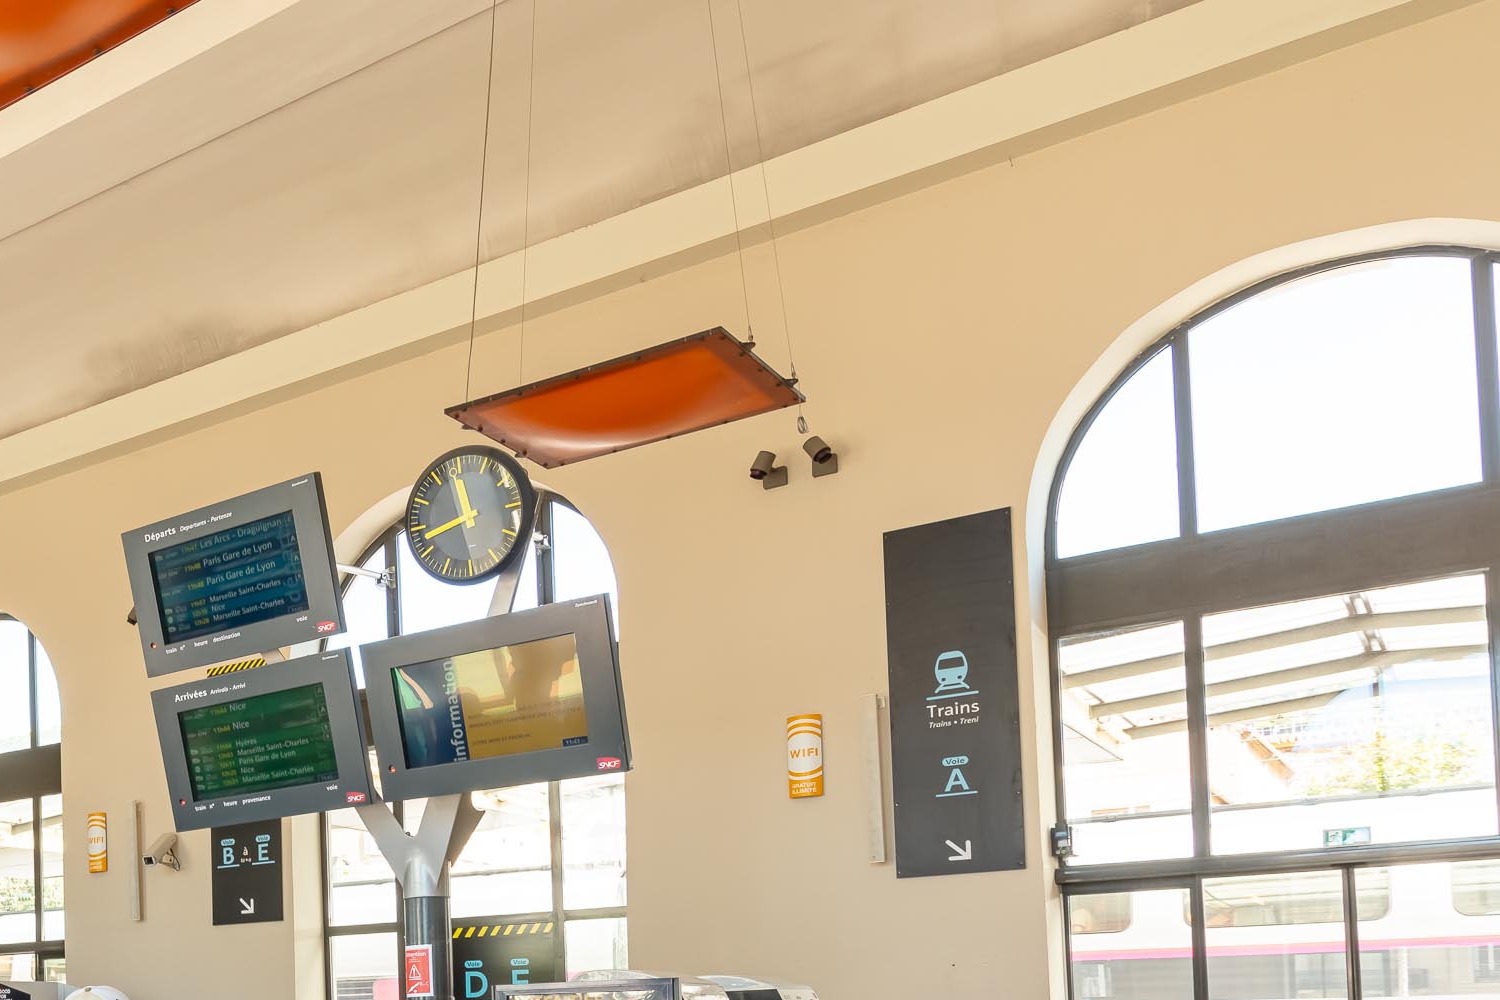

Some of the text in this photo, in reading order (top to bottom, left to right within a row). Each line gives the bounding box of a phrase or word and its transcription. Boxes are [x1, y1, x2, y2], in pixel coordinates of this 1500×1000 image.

[144, 525, 177, 543] Départs
[179, 518, 207, 532] Departures
[199, 539, 213, 549] Les
[213, 533, 231, 545] Arcs
[237, 518, 282, 538] Draguignan
[202, 555, 222, 567] Paris
[221, 550, 241, 562] Gare
[241, 547, 252, 556] de
[252, 541, 273, 554] Lyon
[206, 574, 225, 586] Paris
[225, 569, 244, 581] Gare
[244, 565, 256, 575] de
[256, 560, 277, 574] Lyon
[208, 590, 238, 603] Marseille
[238, 579, 282, 596] Saint-Charles
[211, 603, 226, 613] Nice
[212, 609, 242, 622] Marseille
[241, 598, 285, 615] Saint-Charles
[296, 615, 308, 623] voie
[194, 639, 208, 648] heure
[212, 631, 241, 643] destination
[174, 688, 208, 703] Arrivées
[228, 702, 247, 713] Nice
[443, 659, 469, 763] information
[926, 701, 980, 720] Trains
[232, 720, 250, 731] Nice
[928, 715, 979, 730] Trains Treni
[235, 736, 258, 749] Hyères
[237, 745, 265, 757] Marseille
[265, 736, 309, 751] Saint-Charles
[238, 757, 254, 766] Paris
[254, 754, 271, 763] Gare
[271, 752, 279, 760] de
[279, 749, 297, 760] Lyon
[790, 747, 819, 759] WIFI
[945, 756, 965, 766] Voie
[240, 766, 255, 775] Nice
[242, 771, 270, 784] Marseille
[270, 763, 315, 779] Saint-Charles
[598, 760, 620, 770] SNCF
[326, 784, 338, 792] voie
[944, 768, 970, 793] A
[223, 799, 238, 808] heure
[242, 794, 271, 806] provenance
[223, 843, 269, 865] B à E
[465, 970, 489, 999] D
